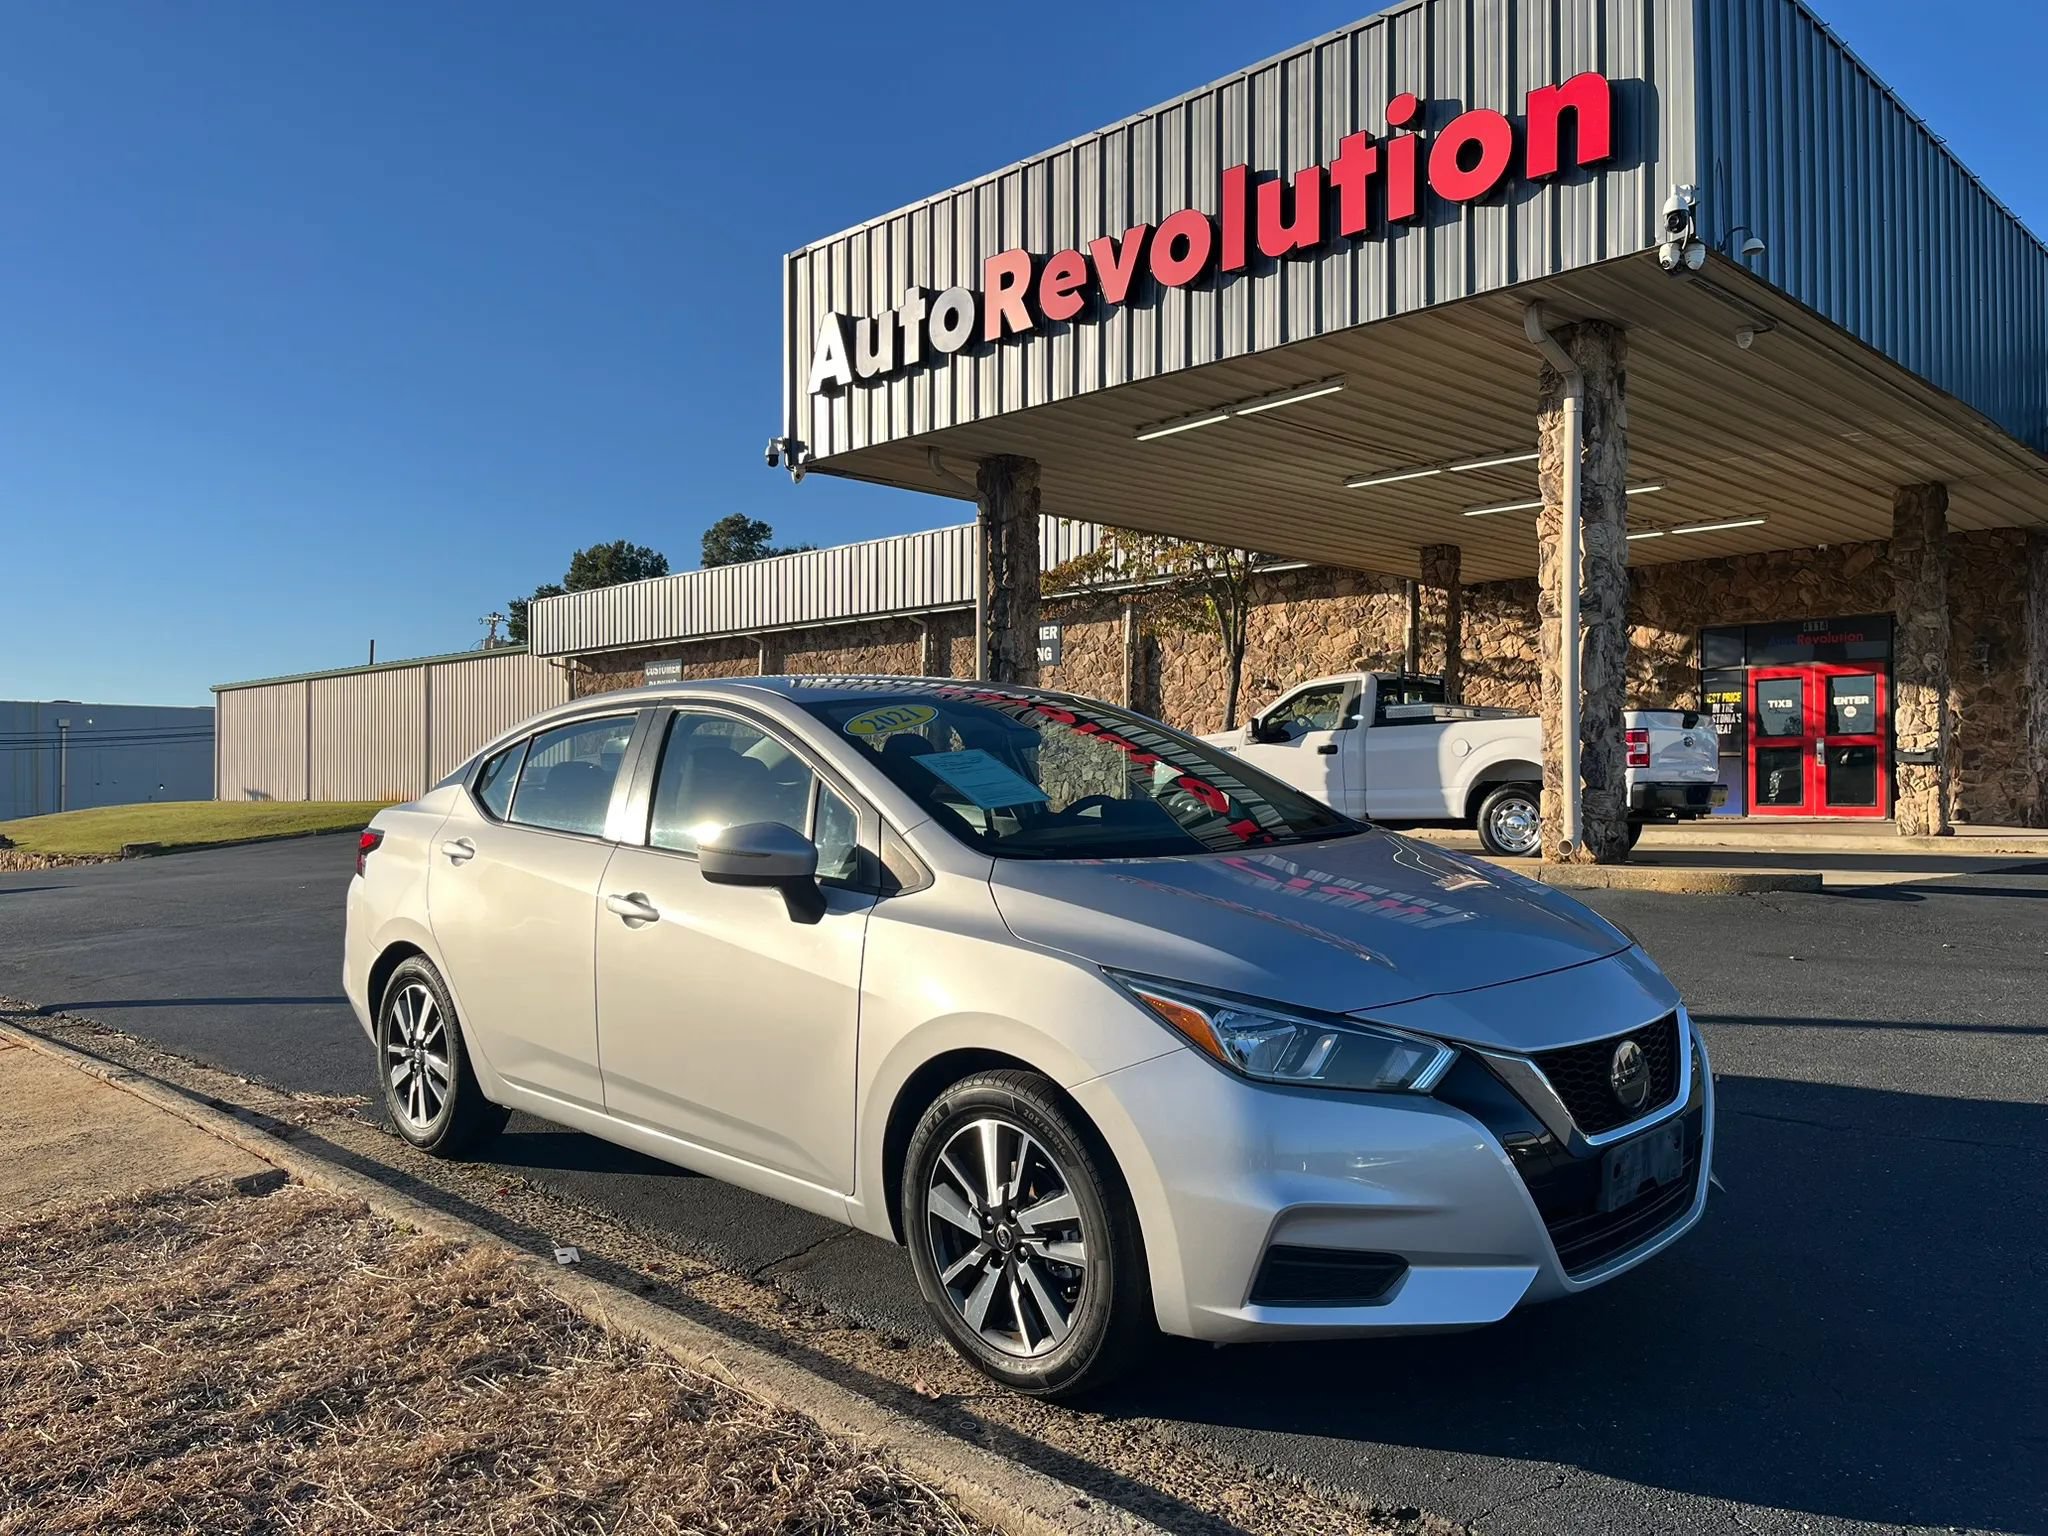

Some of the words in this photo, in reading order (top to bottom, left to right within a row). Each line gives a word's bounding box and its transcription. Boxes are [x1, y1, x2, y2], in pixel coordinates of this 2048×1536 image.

[807, 72, 1610, 394] AutoRevolution
[1833, 695, 1869, 706] ENTER
[1721, 703, 1735, 713] THE
[861, 707, 922, 731] 2021
[1711, 713, 1742, 724] STONIA'S
